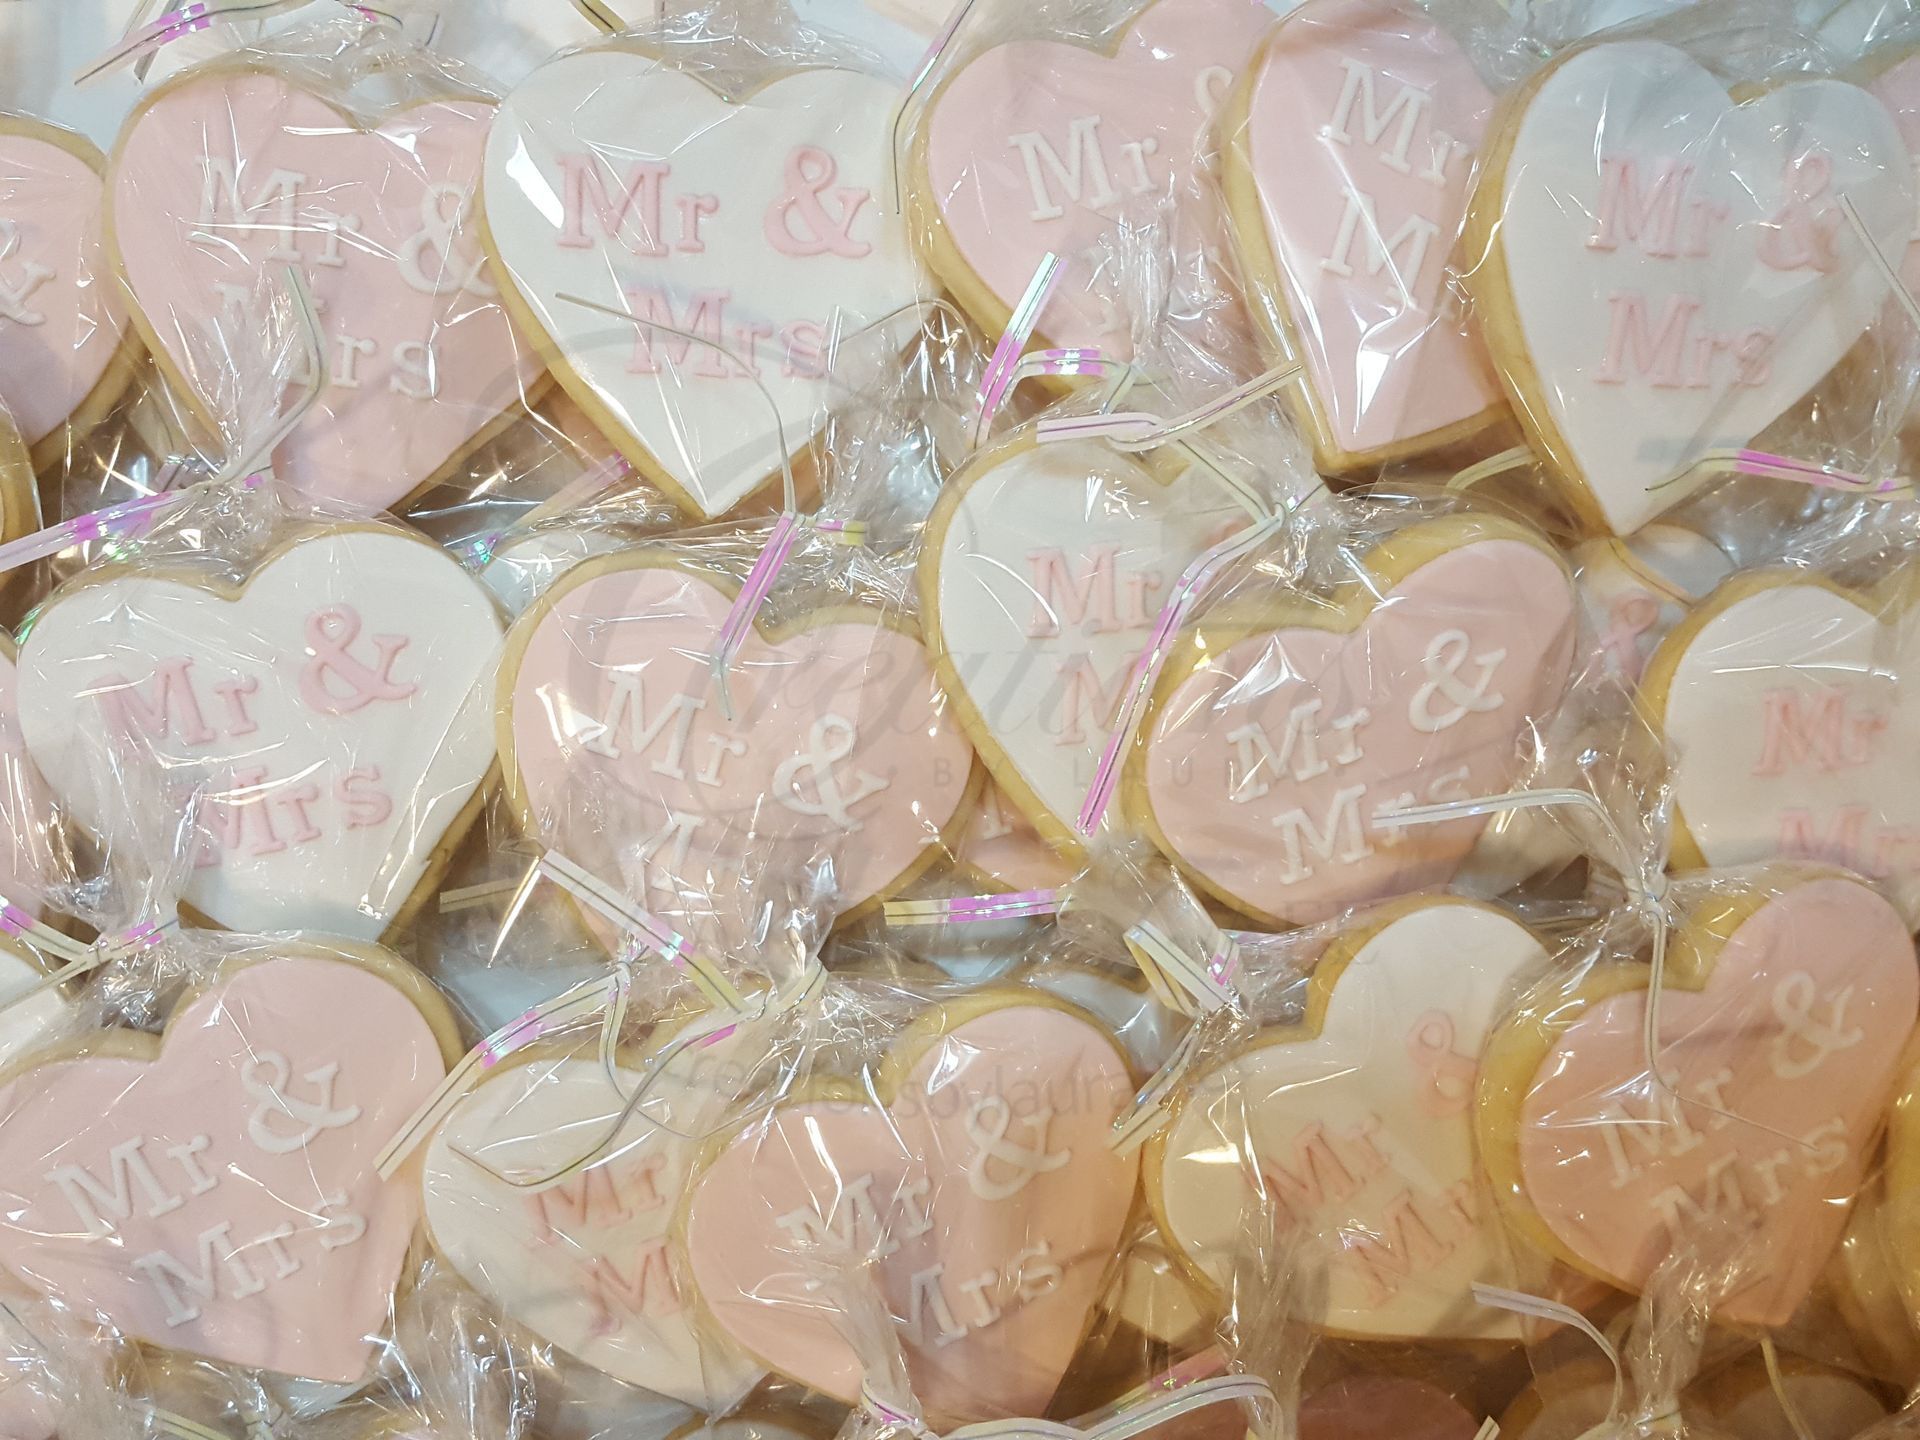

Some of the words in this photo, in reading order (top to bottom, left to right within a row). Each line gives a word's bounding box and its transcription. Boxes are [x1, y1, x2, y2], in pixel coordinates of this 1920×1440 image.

[1008, 114, 1158, 222] Mr
[1322, 58, 1470, 188] Mr
[187, 155, 362, 267] Mr
[399, 180, 500, 296] &
[554, 153, 720, 258] Mr
[763, 144, 873, 259] &
[1585, 154, 1732, 260] Mr
[624, 284, 828, 380] Mrs
[1593, 289, 1778, 389] Mrs
[1027, 541, 1160, 639] Mr
[86, 656, 260, 762] Mr
[302, 603, 419, 716] &
[1225, 697, 1371, 805] Mr
[1408, 629, 1508, 733] &
[1752, 685, 1890, 778] Mr
[584, 670, 748, 788] Mr
[772, 713, 893, 831] &
[168, 763, 394, 870] Mrs
[1769, 970, 1865, 1080] &
[241, 1050, 362, 1154] &
[963, 1095, 1073, 1201] &
[1600, 1067, 1733, 1192] Mr
[44, 1134, 219, 1244] Mr
[522, 1151, 669, 1246] Mr
[774, 1172, 935, 1264] Mr
[1250, 1112, 1392, 1236] Mr
[1650, 1116, 1849, 1240] Mrs
[132, 1186, 368, 1329] Mrs
